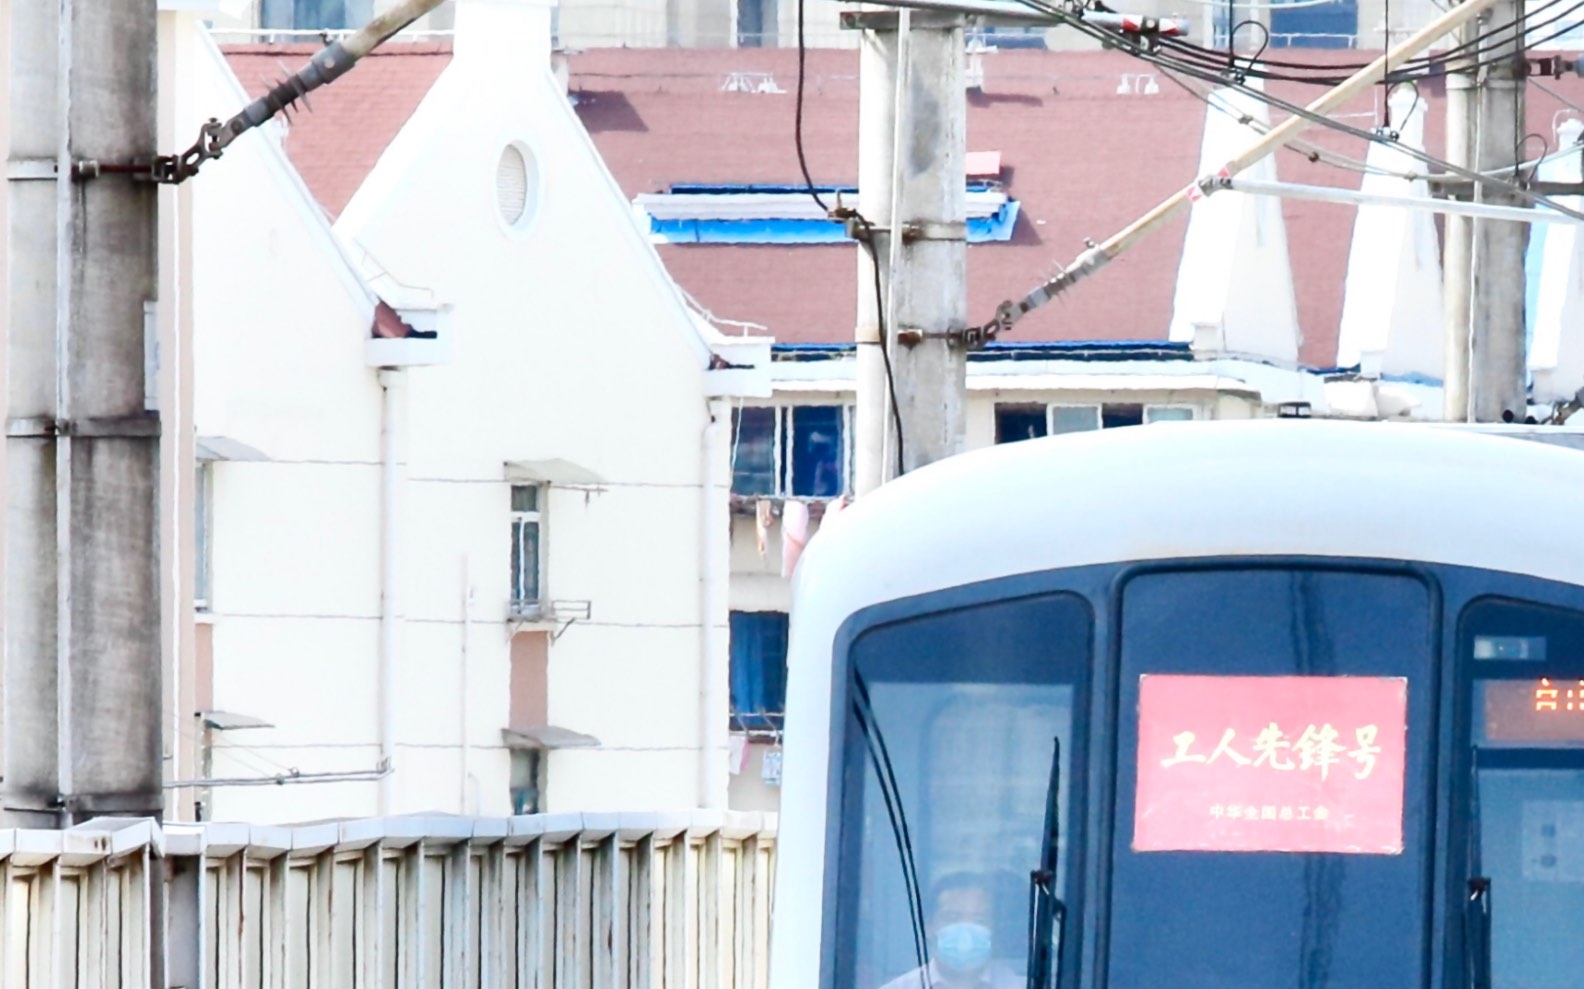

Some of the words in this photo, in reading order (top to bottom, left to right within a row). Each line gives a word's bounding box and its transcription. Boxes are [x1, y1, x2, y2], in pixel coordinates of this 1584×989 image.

[1160, 722, 1382, 782] 工人先锋号
[1209, 804, 1329, 821] 中华全国总工会
